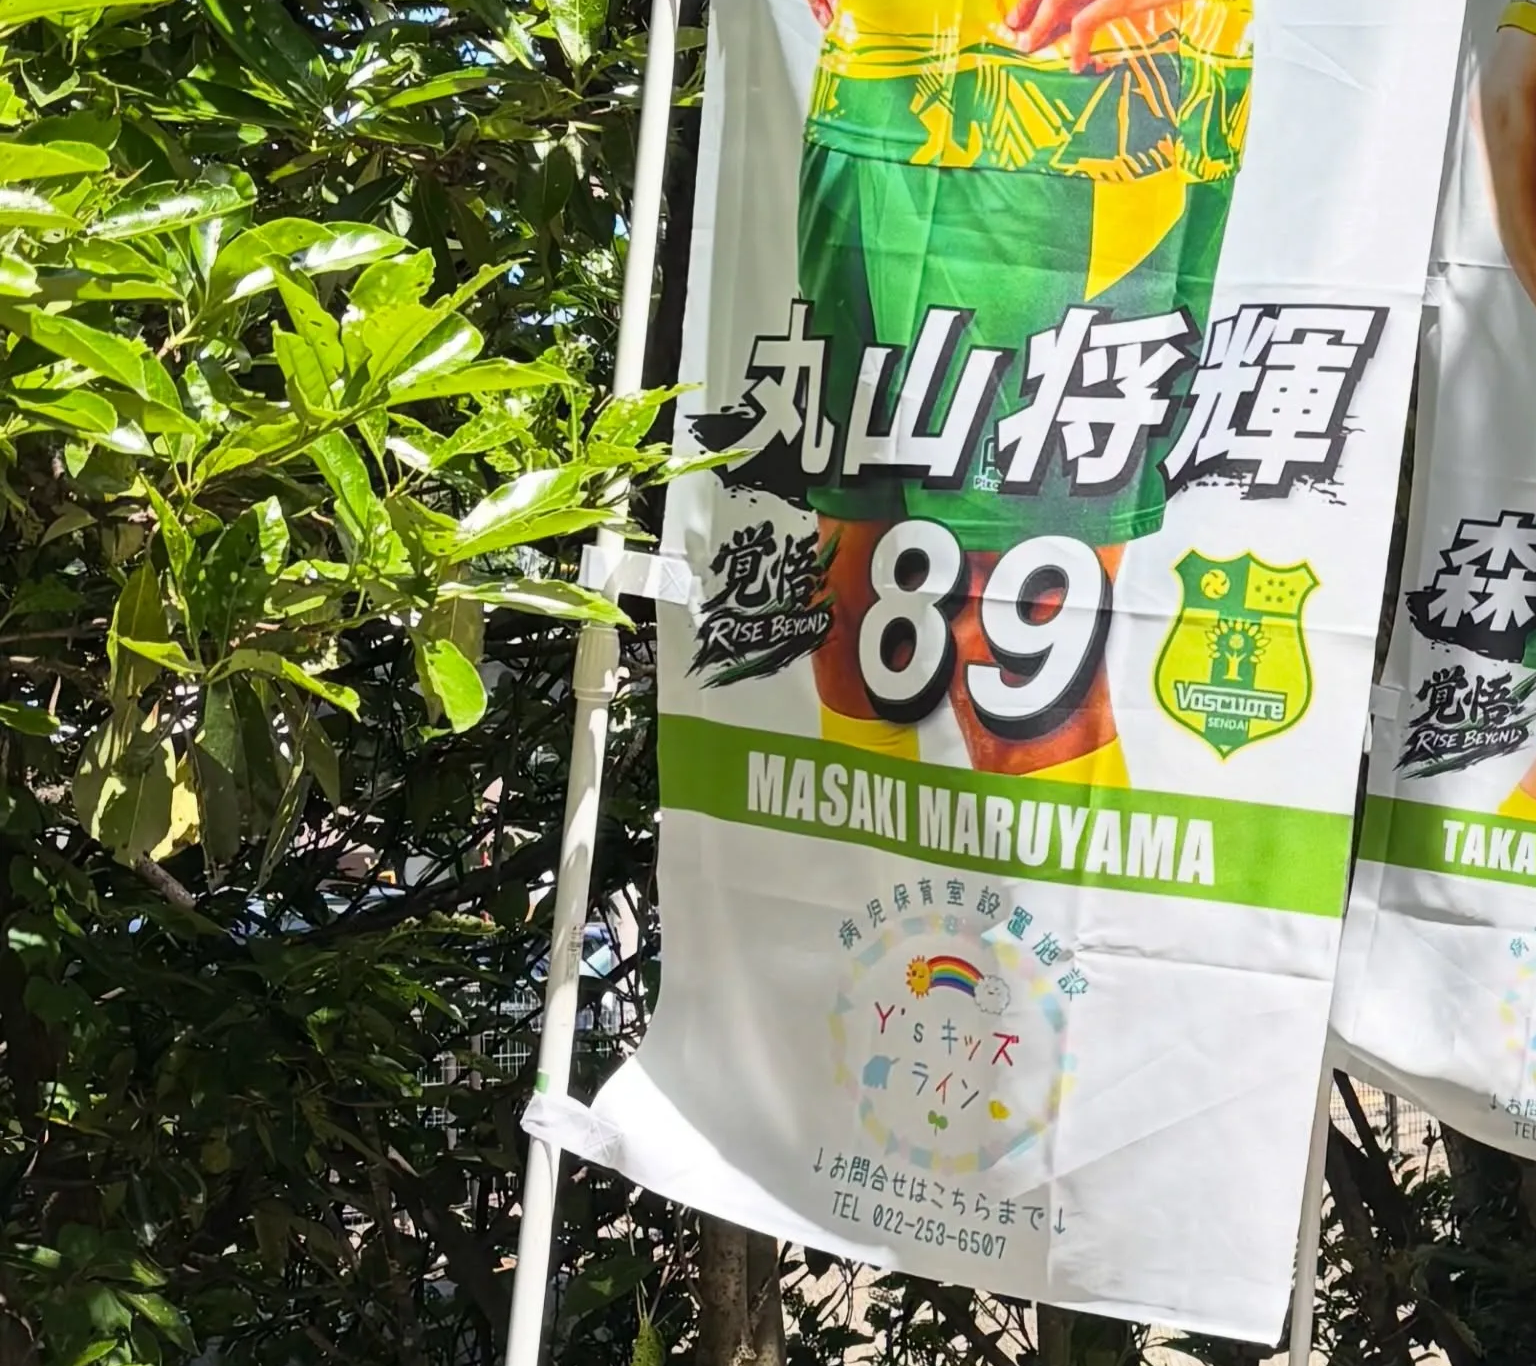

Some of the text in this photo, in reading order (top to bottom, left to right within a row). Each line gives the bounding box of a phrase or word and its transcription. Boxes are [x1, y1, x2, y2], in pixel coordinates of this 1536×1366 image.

[728, 299, 1390, 499] 丸山将輝
[701, 520, 828, 612] 覚悟
[708, 611, 830, 656] RISE BEYOND
[859, 517, 1116, 741] 89
[1207, 716, 1249, 732] SENDAI
[1409, 665, 1525, 727] 覚悟
[1414, 728, 1523, 754] RISE BEYOND
[747, 751, 1217, 887] MASAKI MARUYAMA
[838, 876, 1090, 1001] 病児保育室設置施設
[911, 1061, 980, 1110] ライン
[832, 1190, 1007, 1260] TEL 022-253-6507
